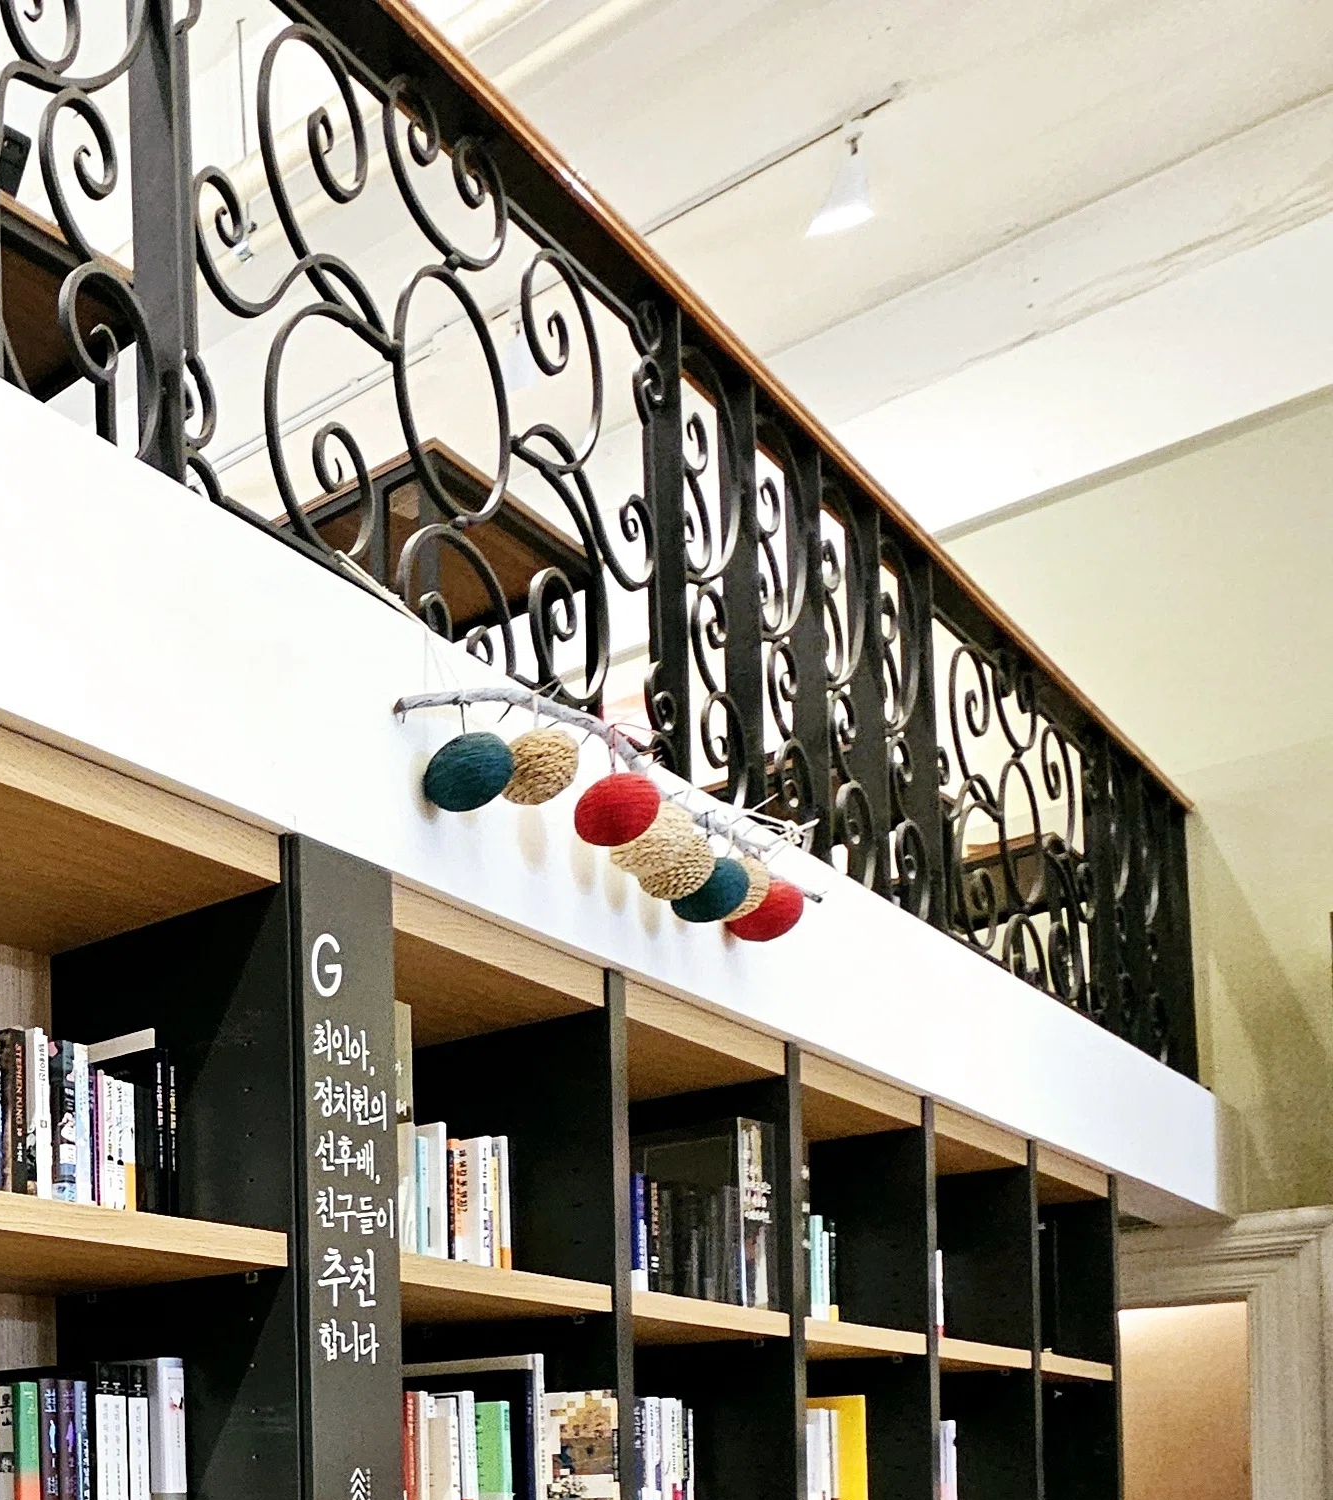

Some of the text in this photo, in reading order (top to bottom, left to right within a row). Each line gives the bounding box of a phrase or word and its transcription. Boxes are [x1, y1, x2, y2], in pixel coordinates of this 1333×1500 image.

[311, 933, 342, 997] G
[313, 1021, 375, 1076] 최인아,
[314, 1077, 388, 1131] 정치헌의
[315, 1132, 381, 1185] 선후배,
[315, 1188, 395, 1239] 친구들이
[317, 1247, 377, 1308] 추천
[318, 1320, 380, 1365] 합니다
